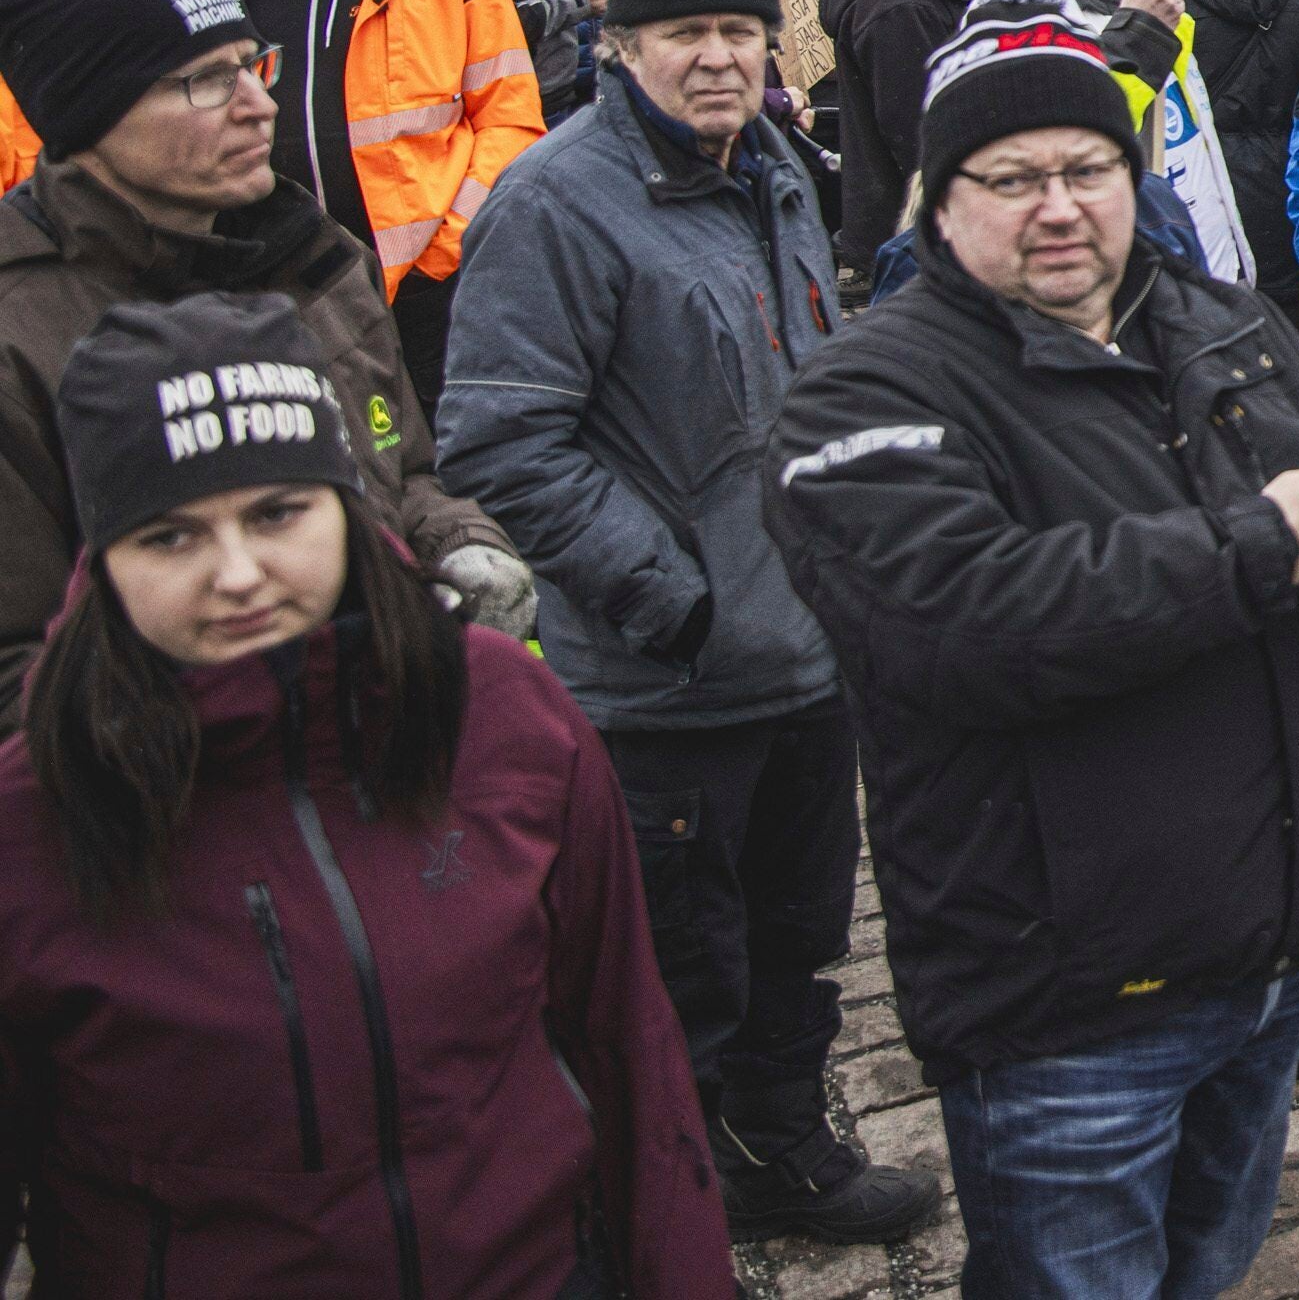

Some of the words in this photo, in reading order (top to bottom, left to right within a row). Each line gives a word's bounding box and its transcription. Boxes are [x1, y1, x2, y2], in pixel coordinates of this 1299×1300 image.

[157, 370, 215, 419] NO
[215, 361, 323, 402] FARMS
[164, 410, 224, 463] NO
[226, 401, 317, 447] FOOD
